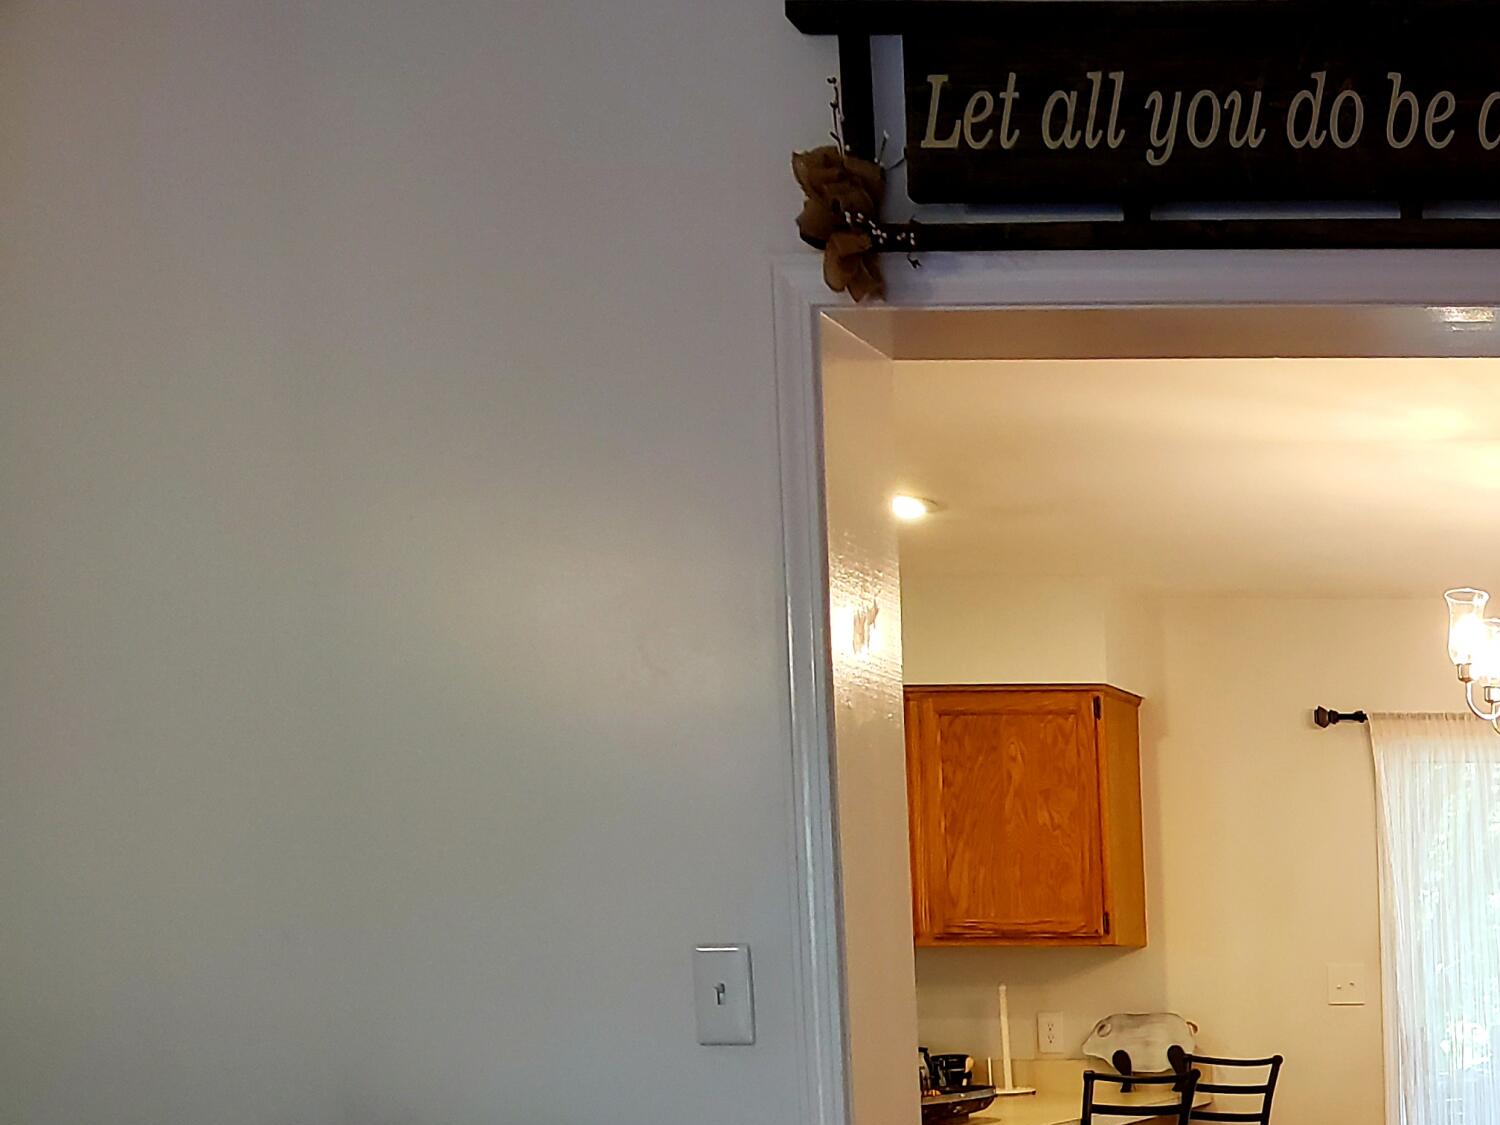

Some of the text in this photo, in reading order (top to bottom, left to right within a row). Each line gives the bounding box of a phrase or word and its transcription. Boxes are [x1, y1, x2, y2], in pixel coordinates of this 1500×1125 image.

[919, 72, 1021, 150] Let
[1040, 71, 1127, 150] all
[1143, 89, 1267, 166] you
[1285, 71, 1365, 150] do
[1385, 71, 1457, 150] be
